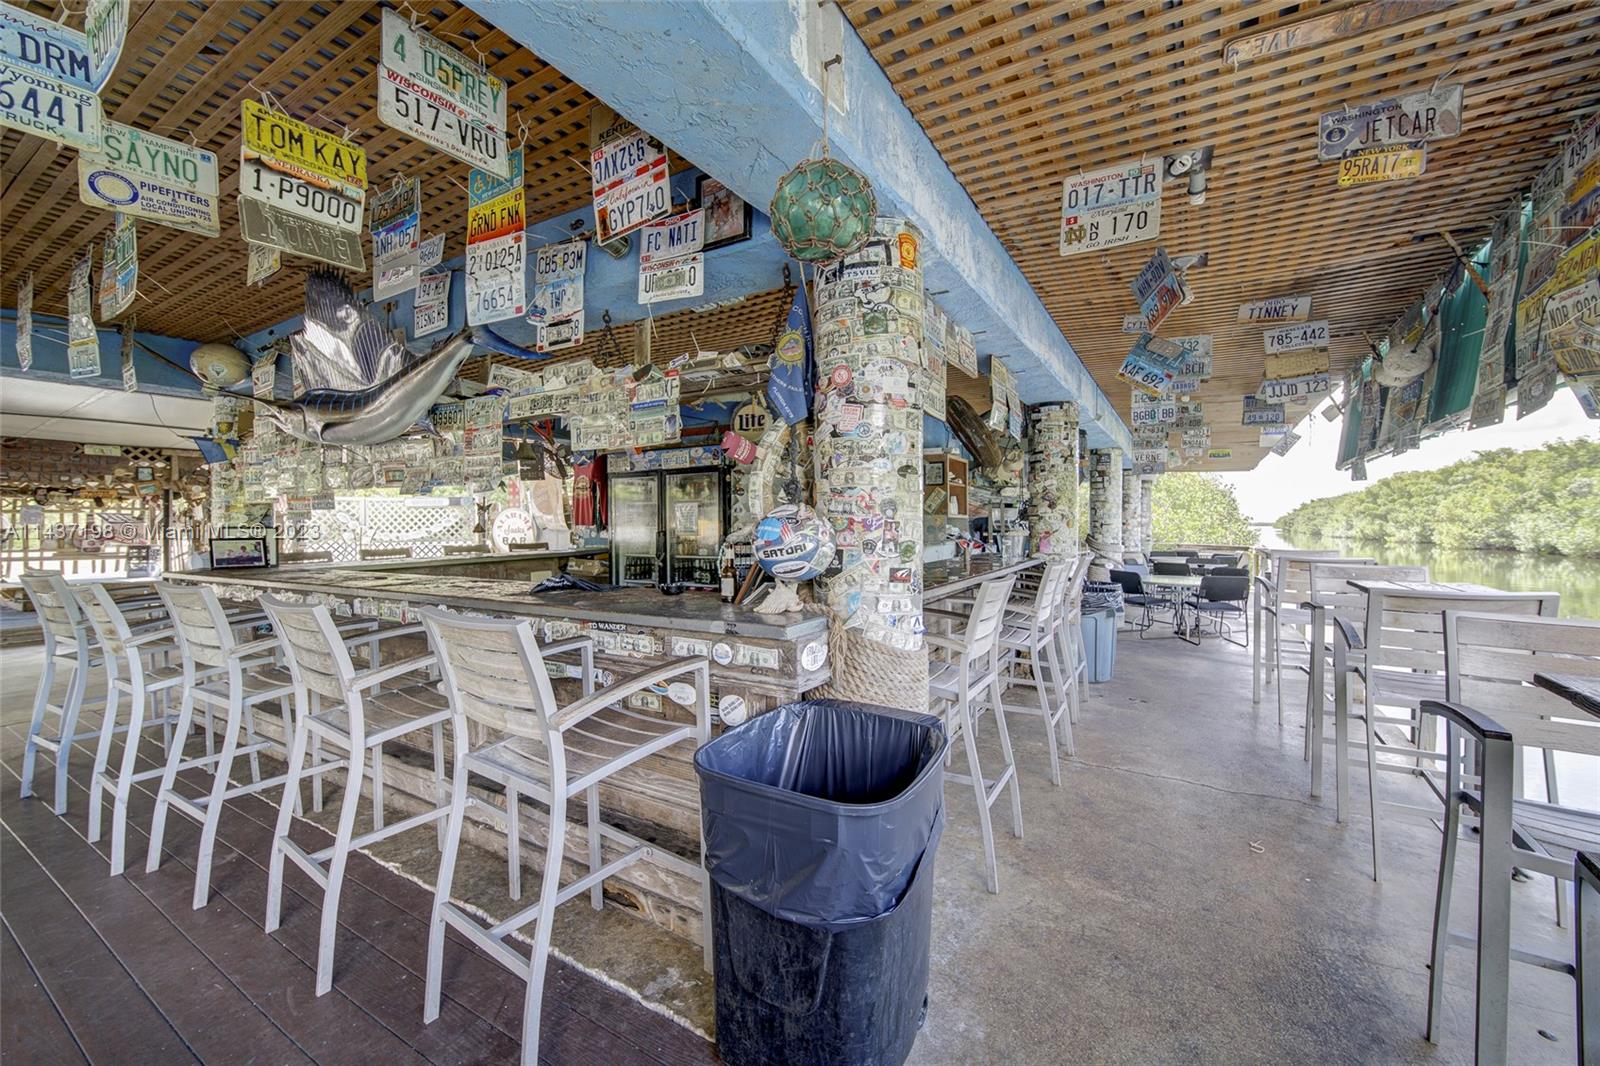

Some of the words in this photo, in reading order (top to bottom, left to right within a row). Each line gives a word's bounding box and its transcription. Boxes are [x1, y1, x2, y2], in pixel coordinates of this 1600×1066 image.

[18, 31, 94, 86] DRM
[387, 69, 458, 114] WISCONSIN
[0, 108, 58, 136] RUCK
[394, 86, 498, 160] 517-VRU
[1330, 103, 1403, 125] WASHINGTON
[1359, 106, 1438, 146] JETCAR
[251, 113, 305, 157] TOM
[313, 139, 361, 176] KAY
[1070, 171, 1124, 189] WASHINGTON
[140, 180, 211, 209] PIPEFITTERS
[141, 195, 154, 204] AIR
[140, 200, 168, 213] LOCAL
[169, 206, 198, 220] UNION
[1111, 210, 1149, 236] 170
[1248, 304, 1299, 320] TINNEY
[1268, 327, 1327, 348] 785-442
[1305, 379, 1329, 395] 123
[738, 413, 765, 432] Lite
[762, 543, 808, 560] SATORI
